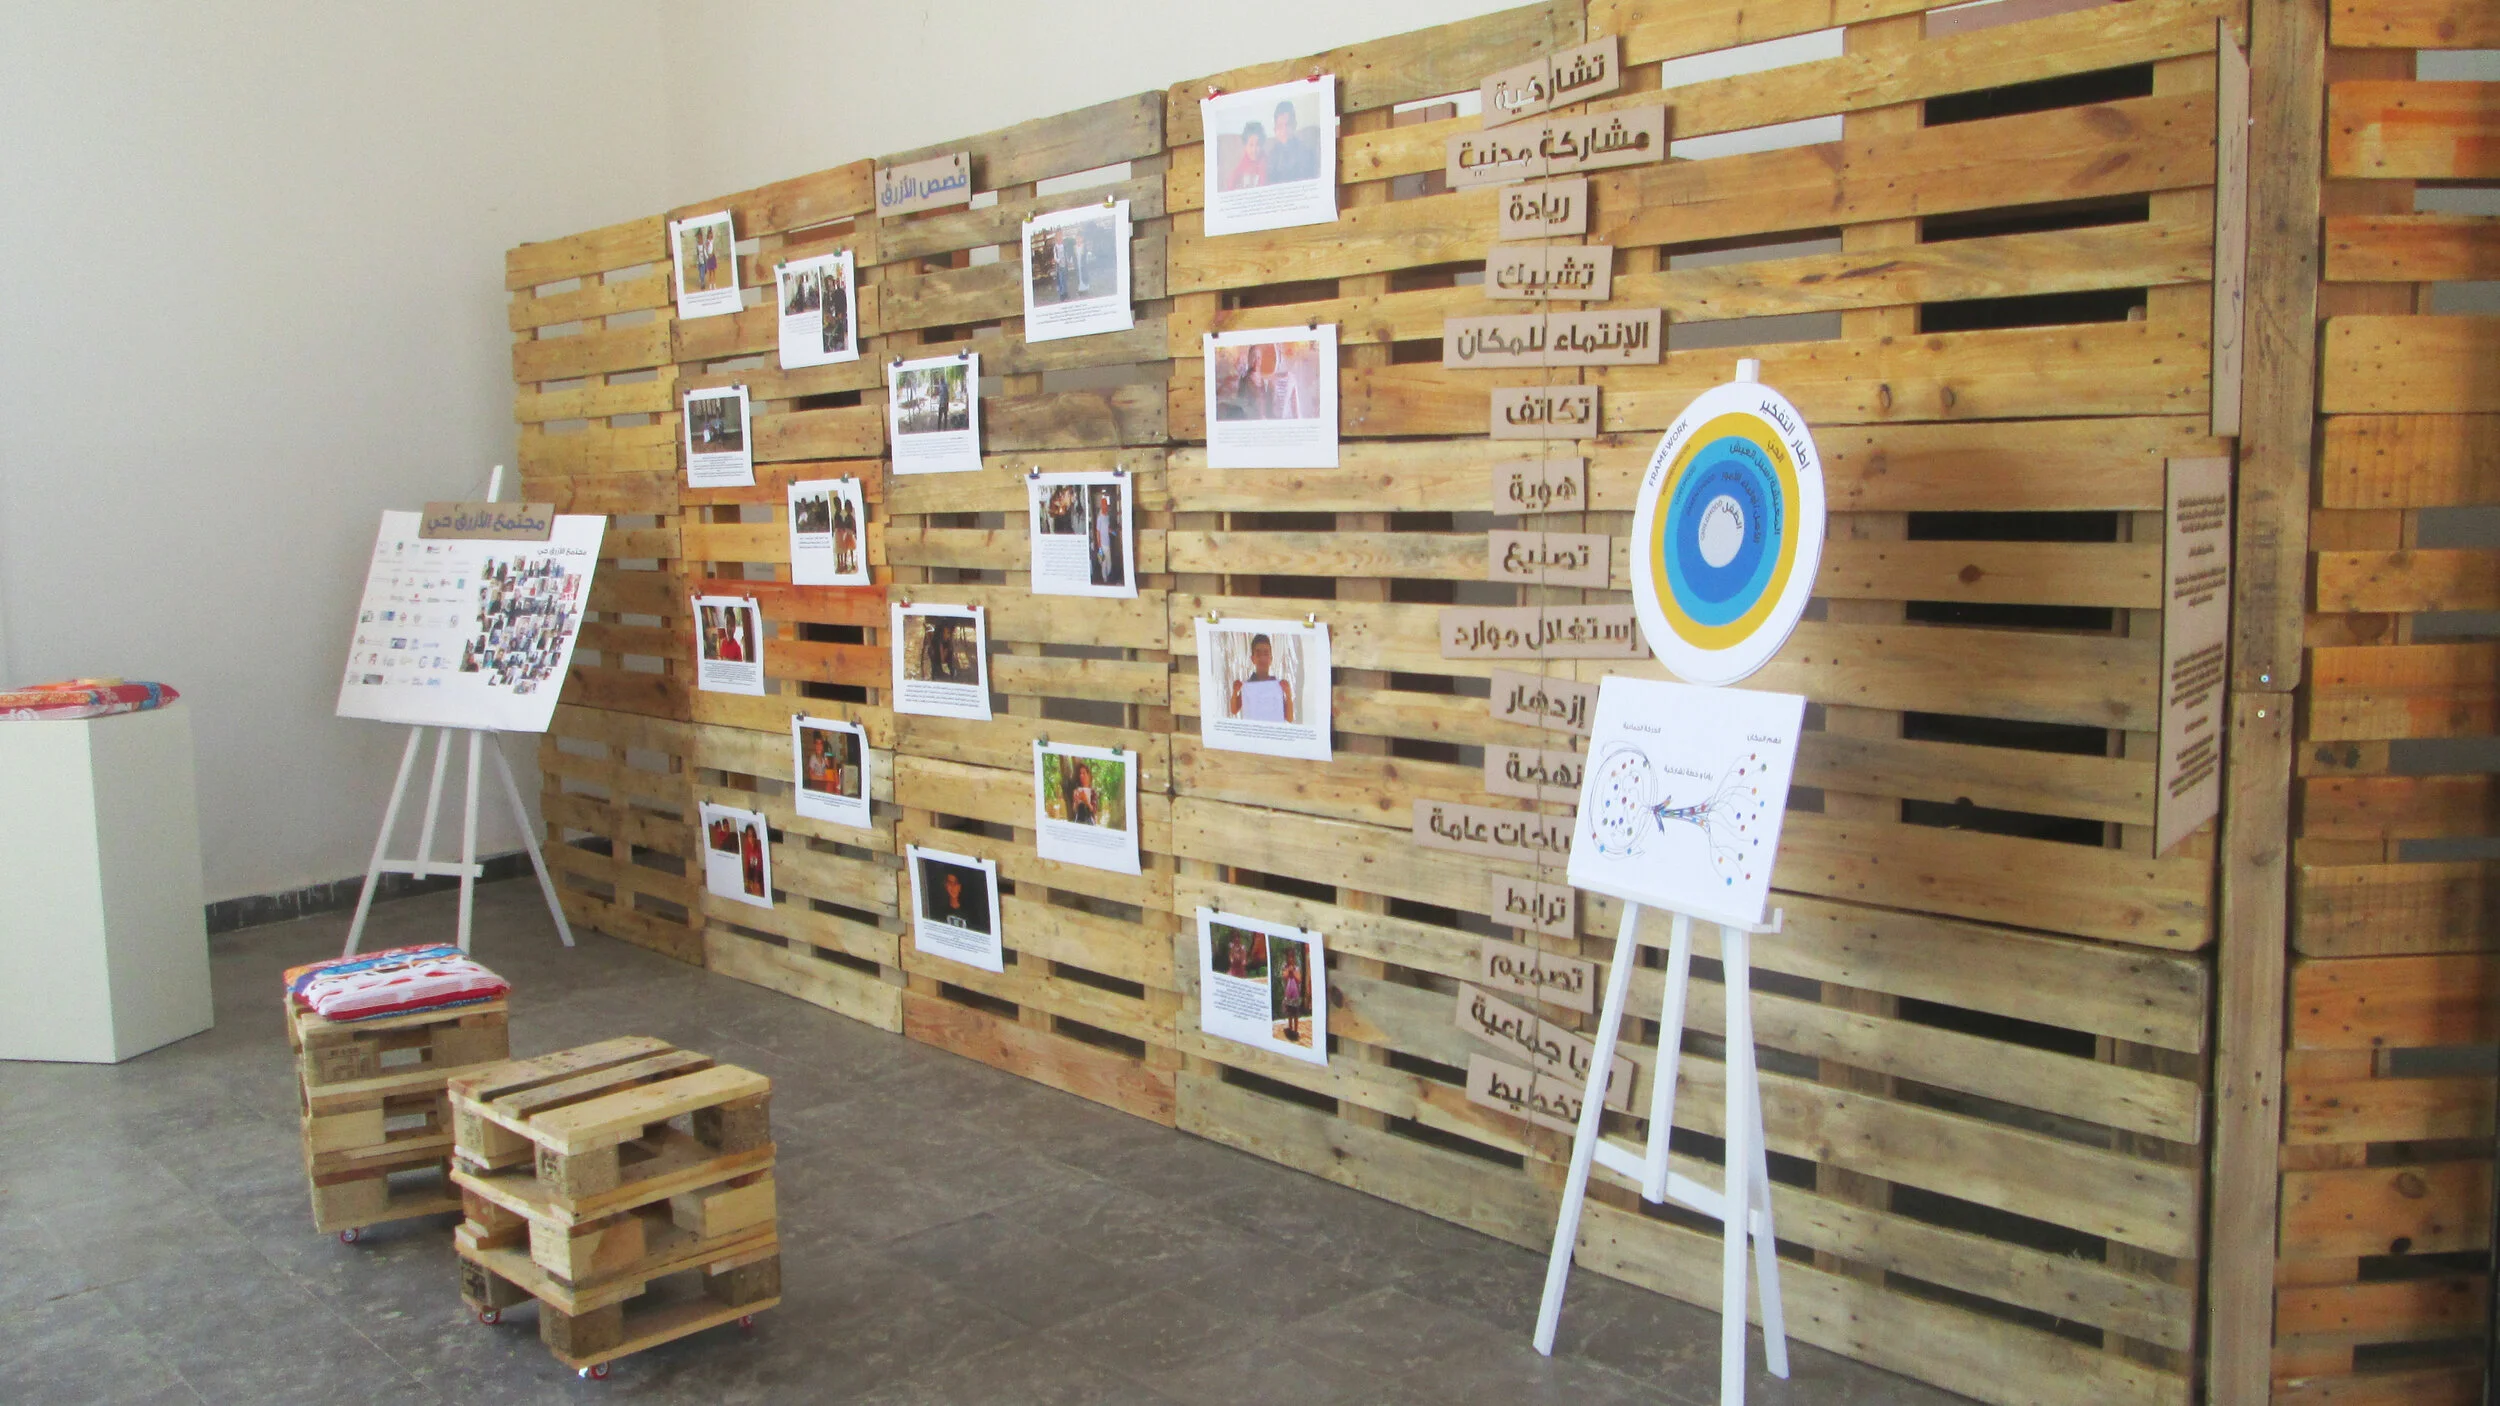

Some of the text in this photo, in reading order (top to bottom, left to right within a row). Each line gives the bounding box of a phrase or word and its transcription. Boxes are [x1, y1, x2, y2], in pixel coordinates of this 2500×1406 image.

[1495, 54, 1605, 114] تشاركية
[1459, 118, 1650, 177] مشاركة مدنية
[881, 167, 967, 207] قصص الأزرق
[1510, 192, 1570, 223] ريادة
[1497, 257, 1594, 295] تشبيك
[1458, 321, 1649, 361] الإنتماء للمكان
[1506, 395, 1590, 424] تكاتف
[1760, 400, 1796, 437] التفكير
[1648, 419, 1688, 487] FRAMEWORK
[1509, 473, 1577, 508] هوية
[428, 514, 452, 535] حي
[494, 513, 545, 533] مجتمع
[1700, 500, 1723, 541] CHILDHOOD
[1722, 502, 1742, 529] الطفل
[1503, 542, 1589, 574] تصنيع
[1455, 617, 1638, 651] إستغلال موارد
[1506, 685, 1586, 728] إزدهار
[1506, 752, 1582, 789] نهضة
[1430, 808, 1488, 841] عامة
[1505, 888, 1565, 925] ترابط
[1490, 955, 1584, 993] تصميم
[1471, 995, 1561, 1066] جماعية
[1489, 1072, 1583, 1124] تخطيط
